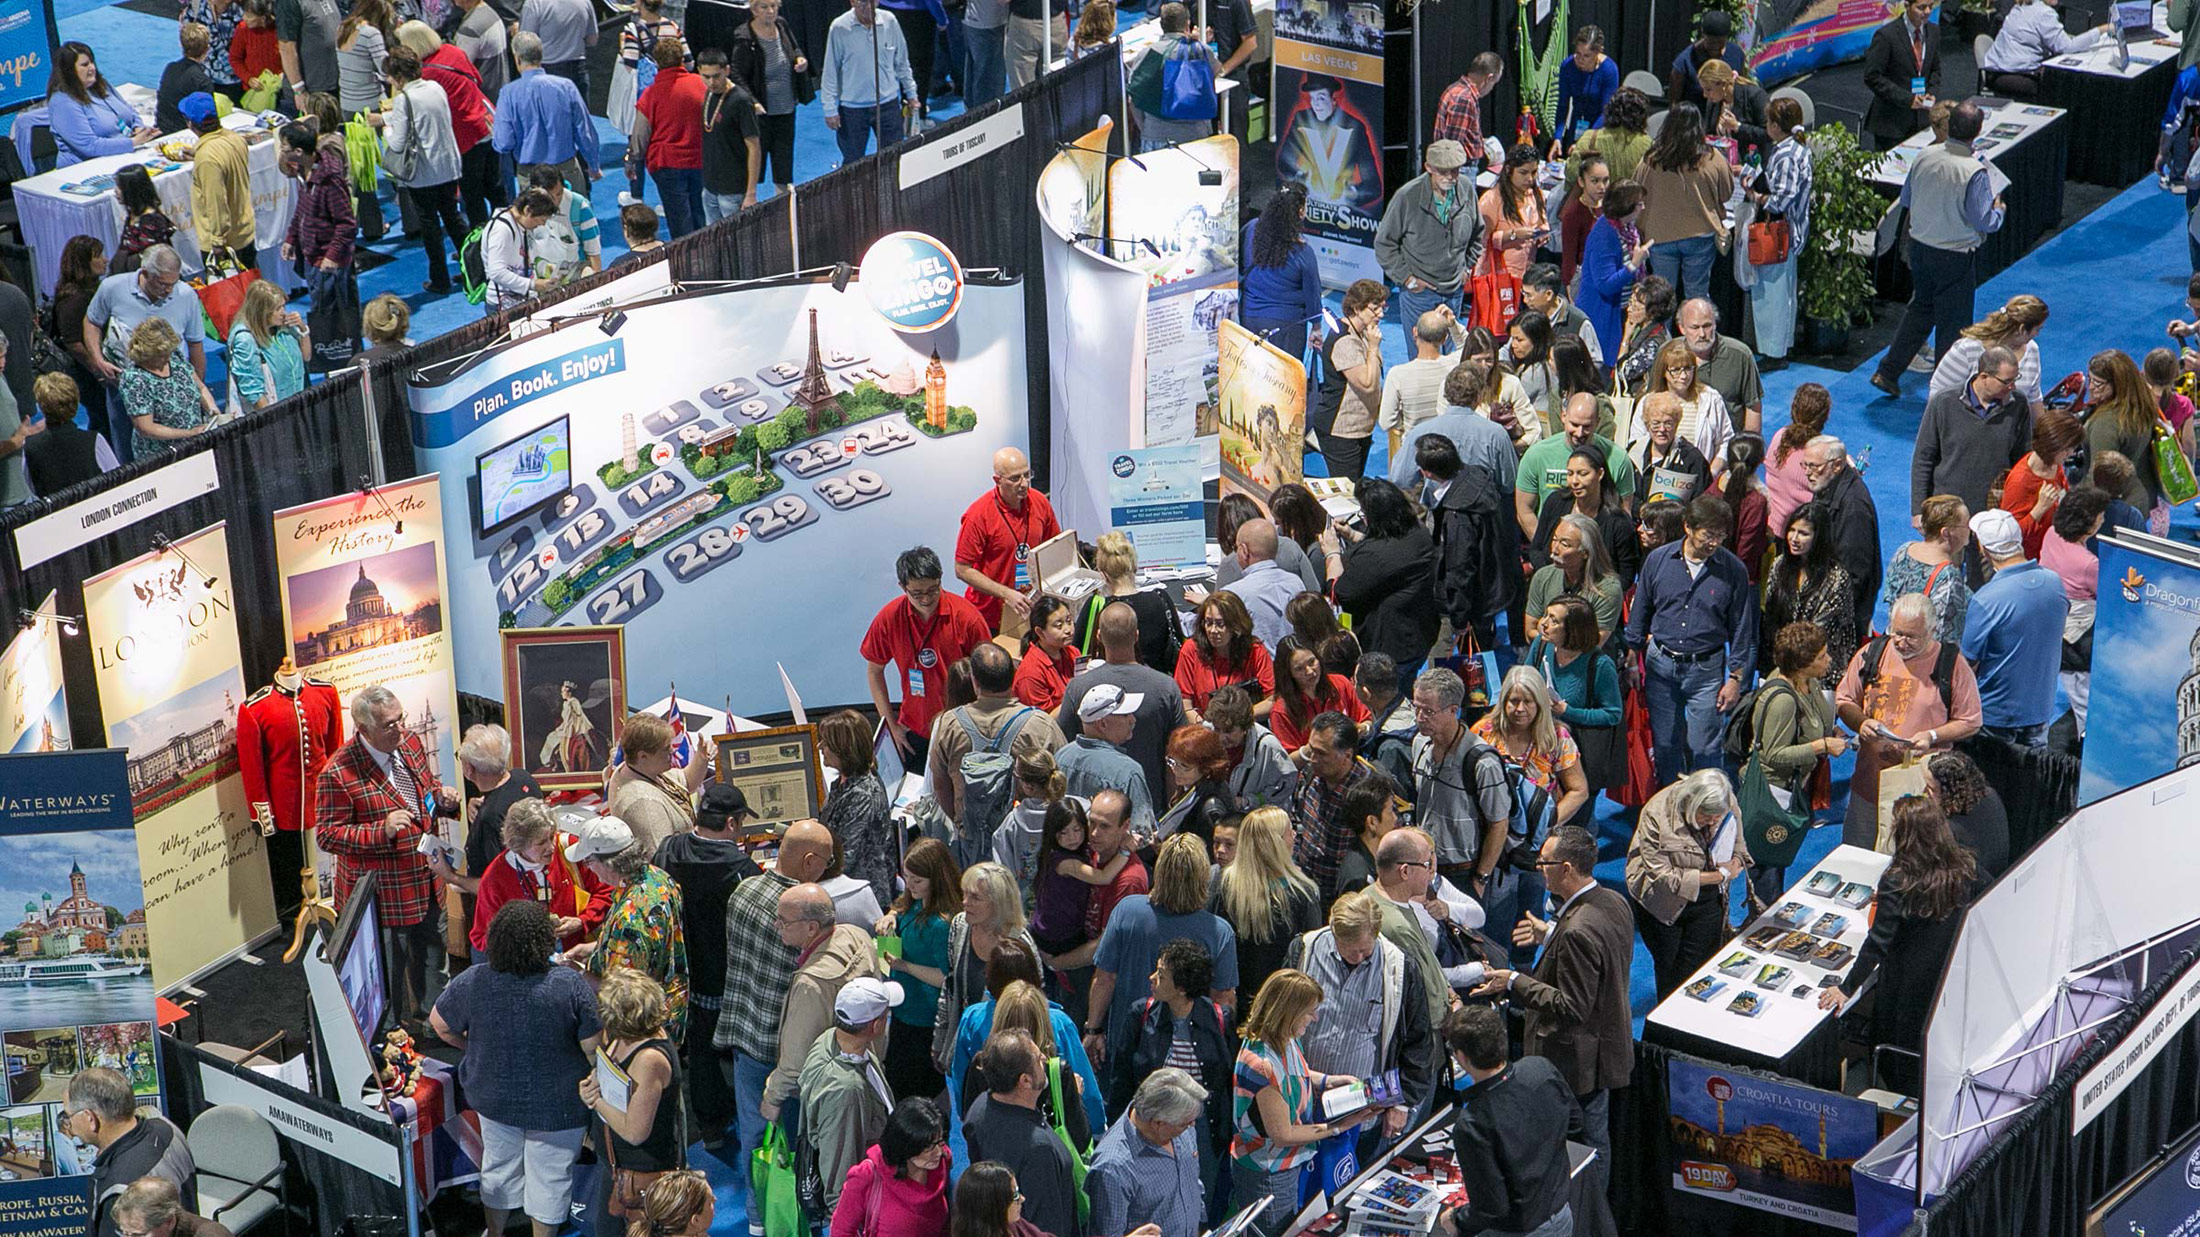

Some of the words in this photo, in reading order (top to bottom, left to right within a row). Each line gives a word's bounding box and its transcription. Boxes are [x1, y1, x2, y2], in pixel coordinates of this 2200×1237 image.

[1301, 51, 1320, 64] LAS
[1323, 55, 1358, 72] VEGAS
[942, 144, 959, 160] TOURS
[959, 141, 965, 153] OF
[966, 132, 987, 150] TUSCANY
[1337, 205, 1380, 232] SHOW
[473, 393, 509, 421] Plan.
[511, 369, 559, 401] Book.
[561, 347, 616, 382] Enjoy!
[772, 361, 800, 379] 3
[713, 381, 746, 401] 2
[657, 407, 680, 424] 1
[739, 399, 769, 420] 9
[850, 420, 910, 451] 24
[784, 439, 842, 473] 23
[627, 472, 676, 508] 14
[819, 468, 883, 506] 30
[1654, 472, 1694, 490] belize
[80, 507, 112, 529] LONDON
[112, 487, 158, 517] CONNECTION
[294, 506, 394, 542] Experience
[394, 494, 426, 514] the
[744, 495, 808, 536] 29
[328, 532, 394, 556] History
[563, 511, 605, 550] 13
[668, 528, 734, 577] 28
[502, 559, 541, 604] 12
[591, 569, 647, 625] 27
[300, 664, 333, 679] Travel
[158, 833, 191, 855] Why
[194, 811, 225, 837] rent
[226, 812, 235, 822] a
[189, 841, 228, 862] When
[145, 893, 171, 910] can
[174, 878, 206, 895] have
[208, 866, 218, 877] a
[220, 836, 259, 869] home!
[2082, 1080, 2103, 1110] UNITED
[2103, 1060, 2125, 1091] STATES
[2126, 1041, 2144, 1071] VIRGIN
[2144, 1017, 2165, 1050] ISLANDS
[2165, 1002, 2178, 1028] DEPT.
[2179, 993, 2187, 1012] OF
[1737, 1086, 1792, 1106] CROATIA
[1793, 1098, 1839, 1117] TOURS
[268, 1105, 334, 1143] AMAWATERWAYS
[1685, 1166, 1701, 1180] 19
[1701, 1169, 1728, 1185] DAY
[49, 1206, 61, 1217] &
[1739, 1192, 1769, 1206] TURKEY
[1770, 1200, 1786, 1211] AND
[1787, 1204, 1819, 1218] CROATIA
